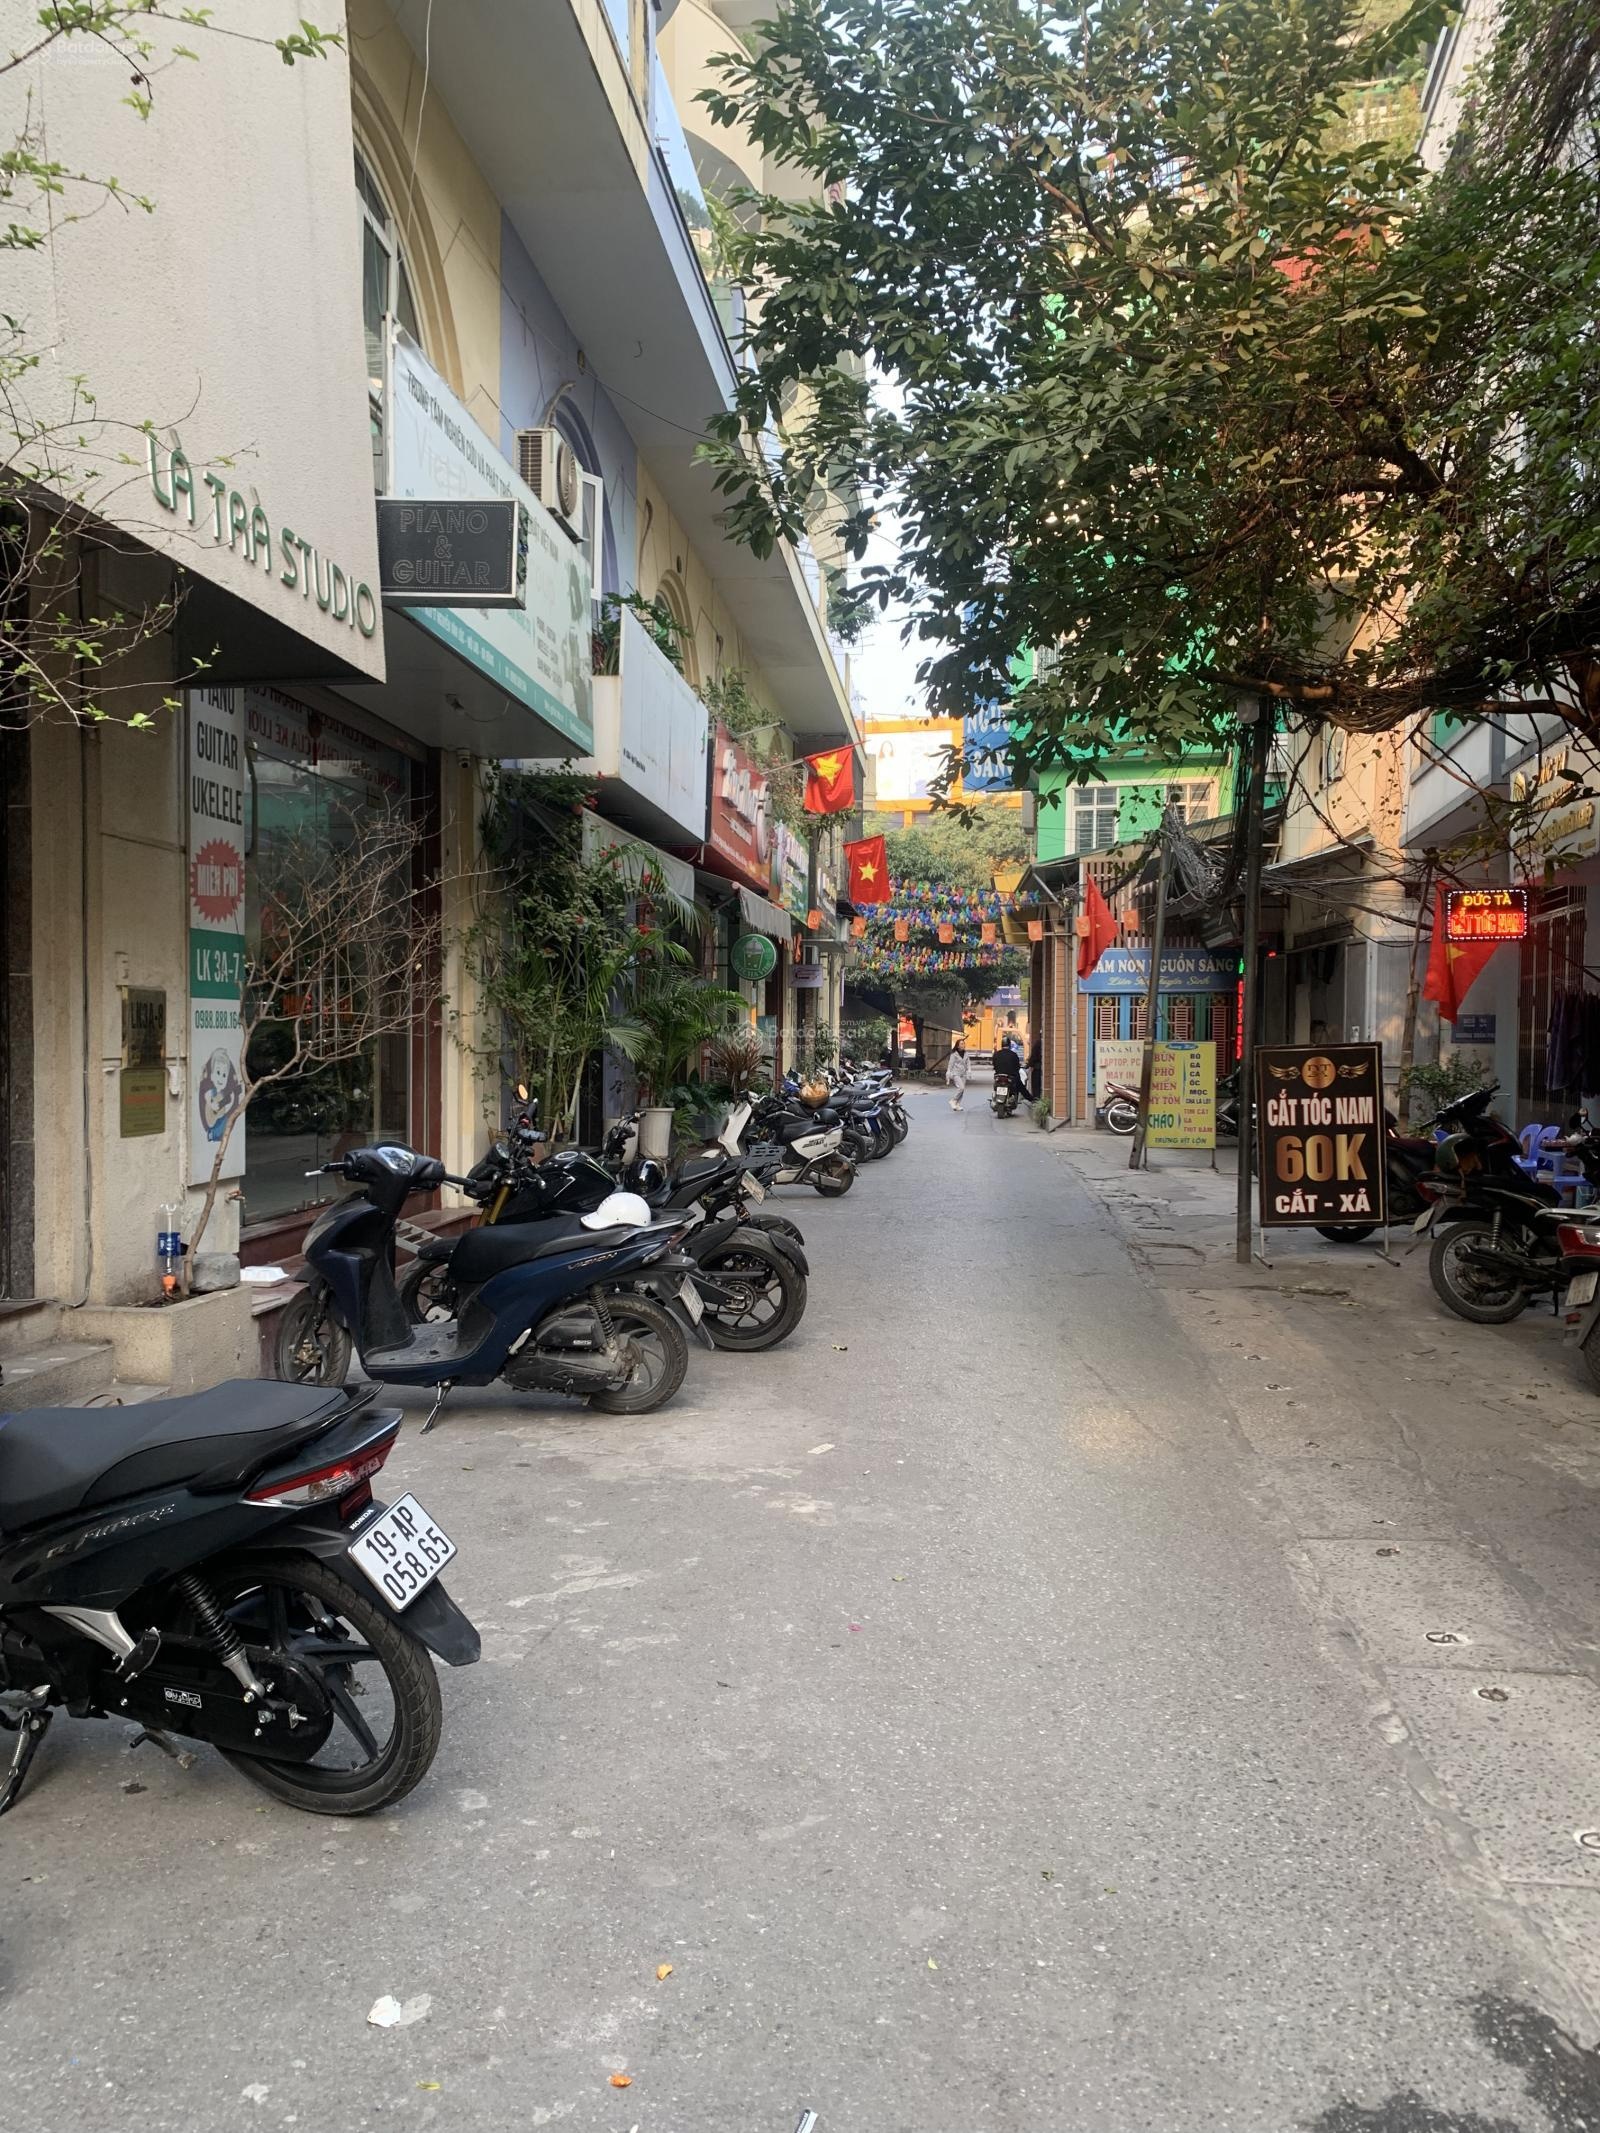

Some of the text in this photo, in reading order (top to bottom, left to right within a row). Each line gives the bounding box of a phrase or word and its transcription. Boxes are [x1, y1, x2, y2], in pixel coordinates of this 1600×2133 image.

[145, 428, 196, 525] LÀ
[203, 470, 272, 575] TRÀ
[280, 527, 377, 638] STUDIO
[399, 508, 489, 534] PIANO
[434, 534, 453, 558] &
[392, 559, 491, 585] GUITAR
[196, 720, 238, 771] GUITAR
[192, 775, 243, 826] UKELELE
[1462, 891, 1513, 906] ĐỨC TÀ
[196, 948, 211, 982] LK
[1118, 958, 1146, 974] NON
[1198, 954, 1234, 974] SÁNG
[1267, 1088, 1374, 1127] CẮT TÓC NAM
[1276, 1133, 1369, 1183] 60K
[1275, 1188, 1319, 1214] CẮT
[1339, 1187, 1372, 1213] XẢ
[349, 1509, 375, 1531] HONDA
[365, 1505, 419, 1565] 19-AP
[382, 1526, 450, 1601] 058.65
